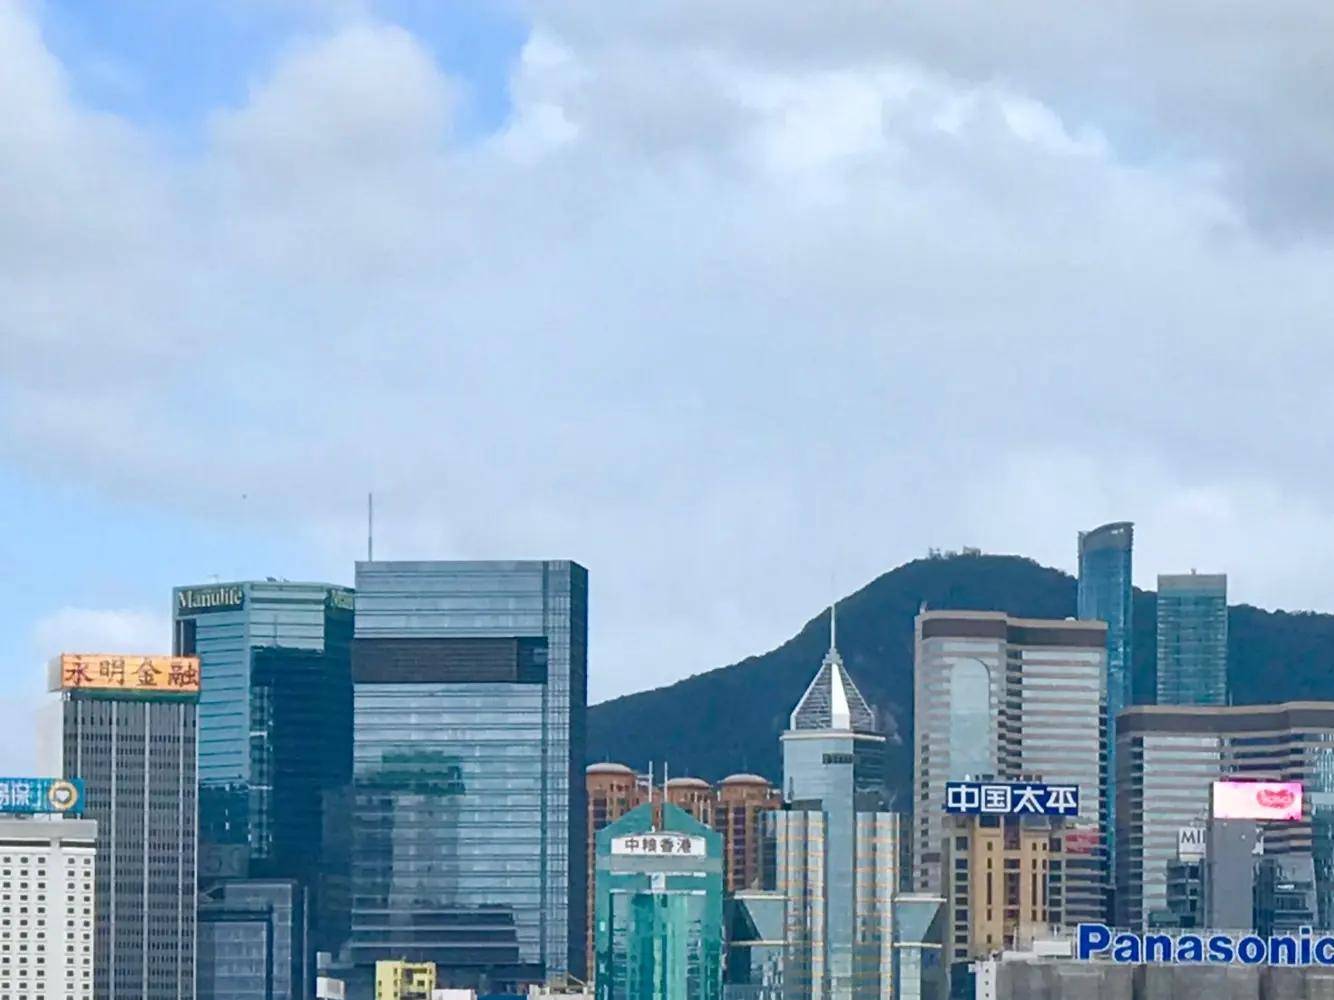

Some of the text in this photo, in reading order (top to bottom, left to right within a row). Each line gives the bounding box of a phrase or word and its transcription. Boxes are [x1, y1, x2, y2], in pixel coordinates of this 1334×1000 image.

[178, 584, 244, 609] Manulife
[65, 655, 199, 687] 永明金融
[947, 784, 1077, 814] 中国太平
